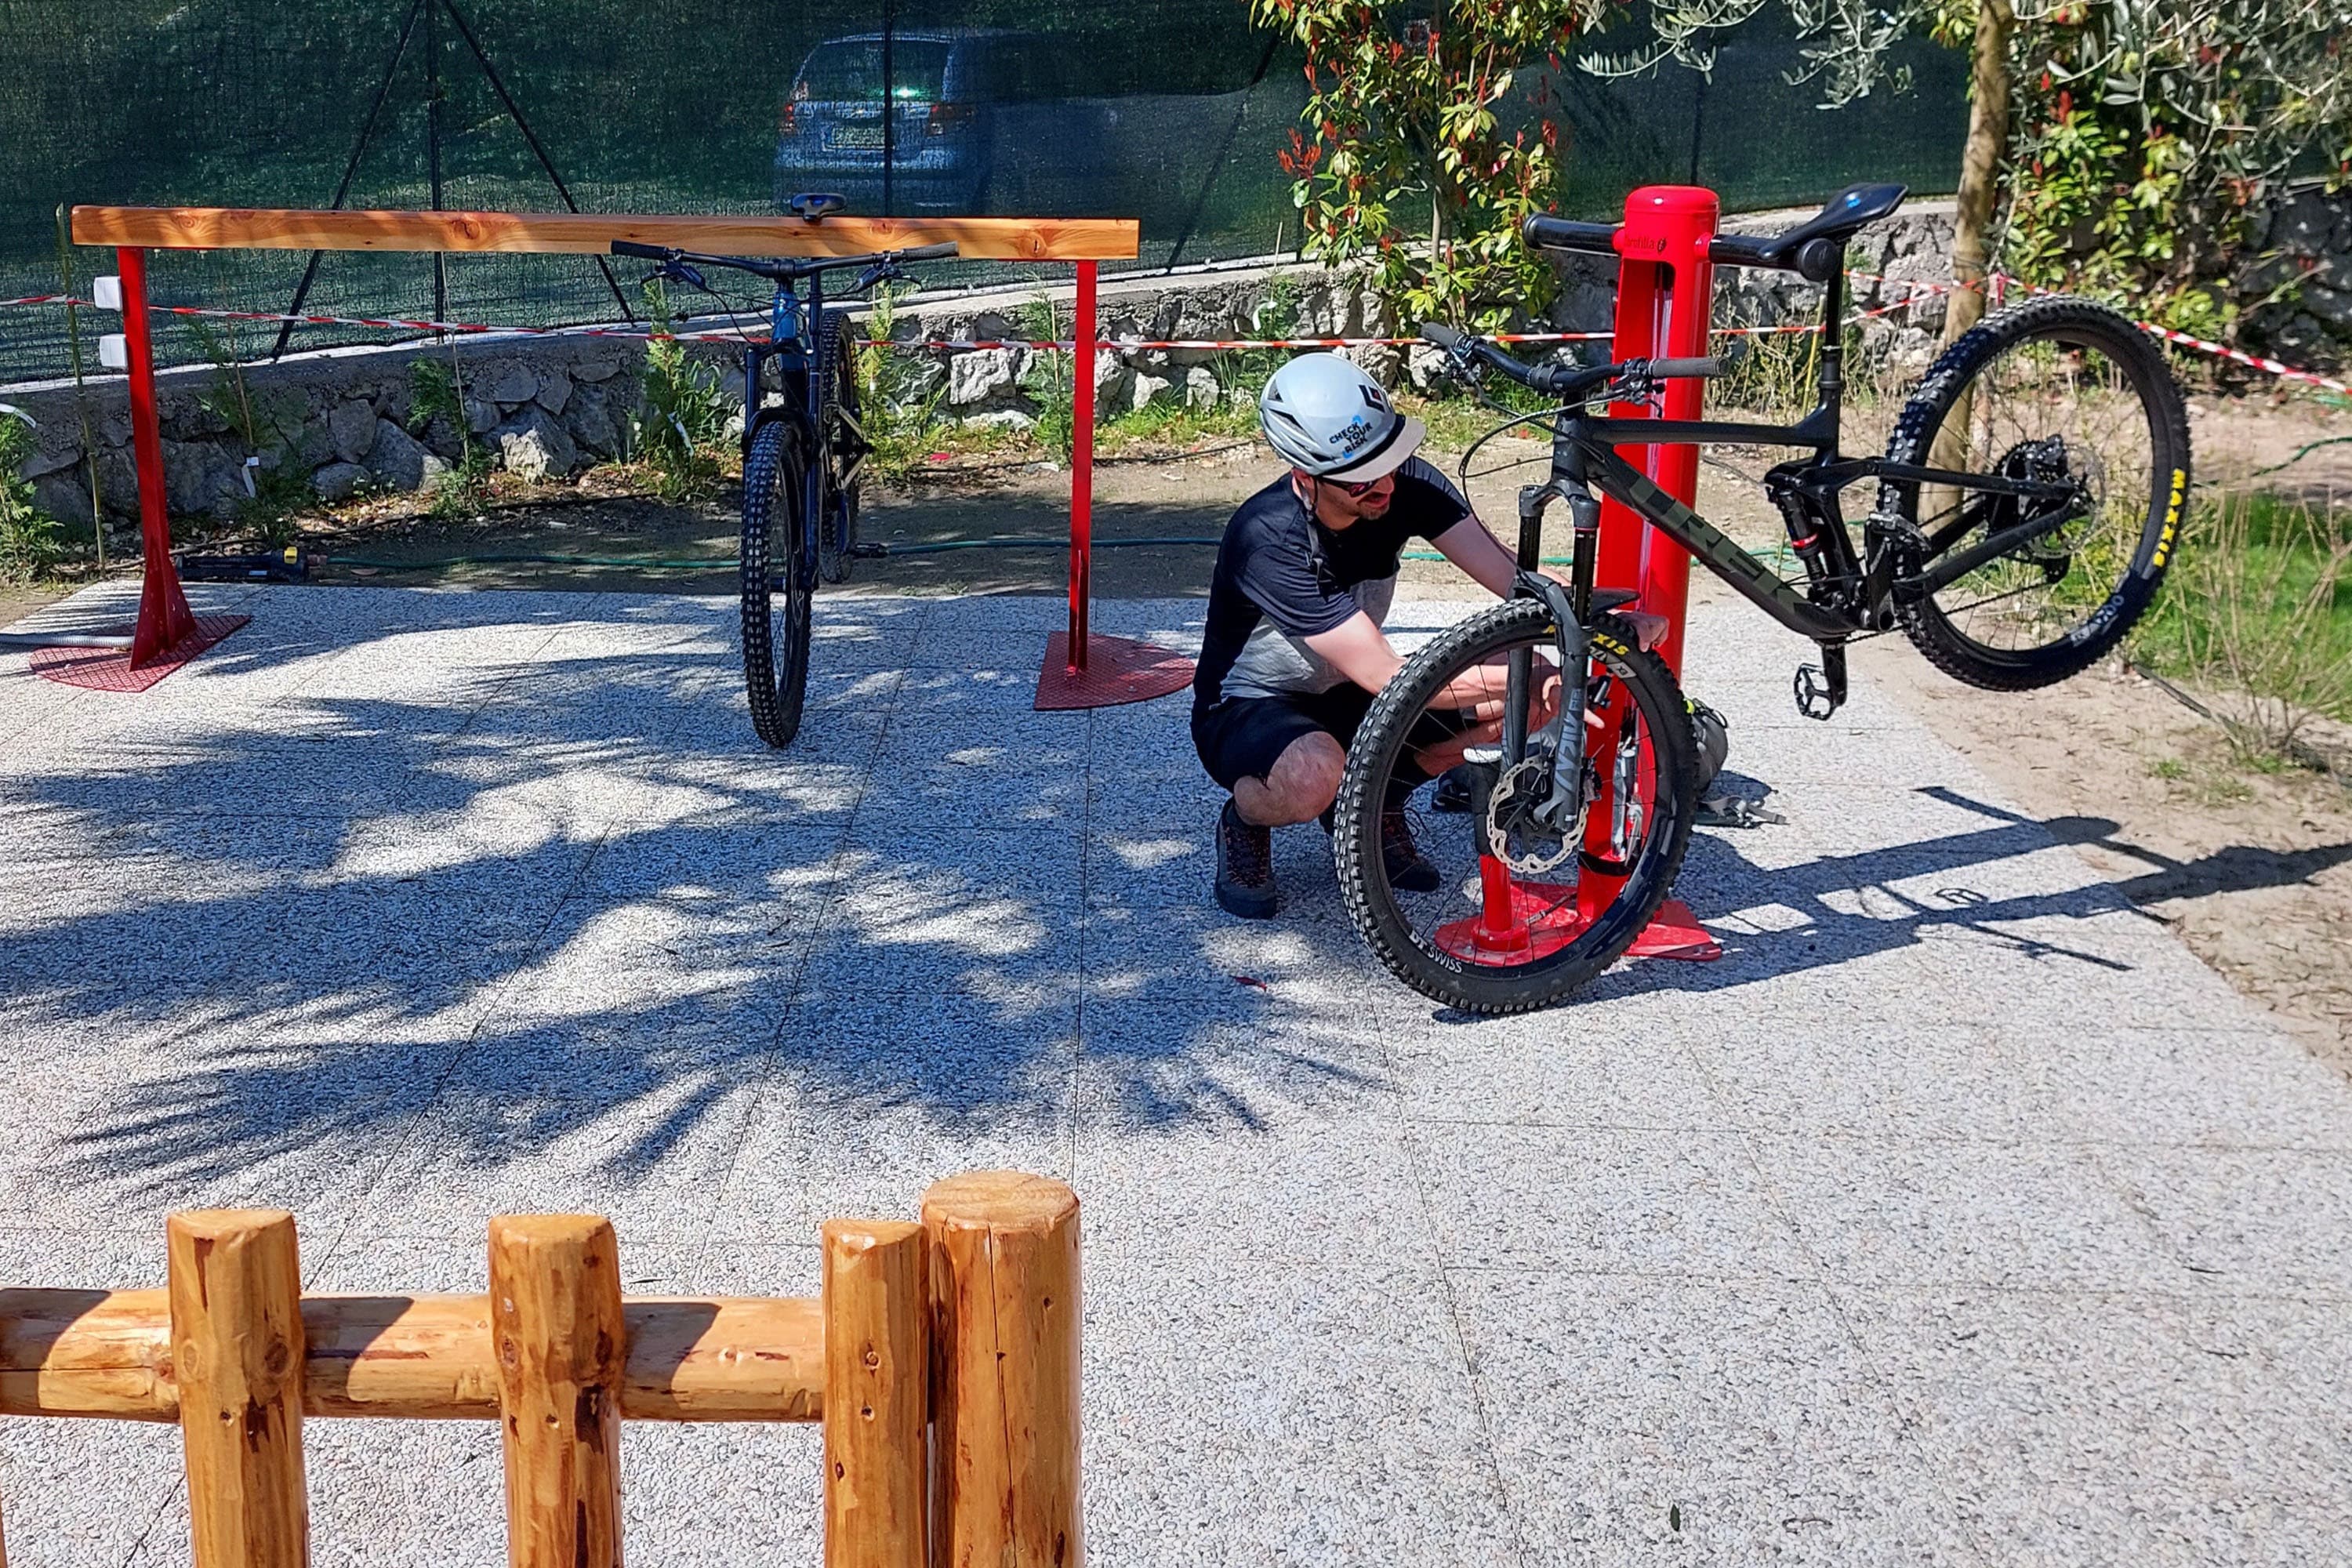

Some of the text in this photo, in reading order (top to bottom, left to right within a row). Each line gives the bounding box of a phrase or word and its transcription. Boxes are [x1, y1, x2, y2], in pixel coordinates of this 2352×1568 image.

[1329, 422, 1360, 445] CHECK
[1345, 434, 1368, 453] RISK
[1346, 422, 1373, 444] YOUR
[2153, 468, 2186, 568] MAXXIS
[1629, 475, 1809, 615] TREK
[1409, 930, 1462, 973] DT SWISS
